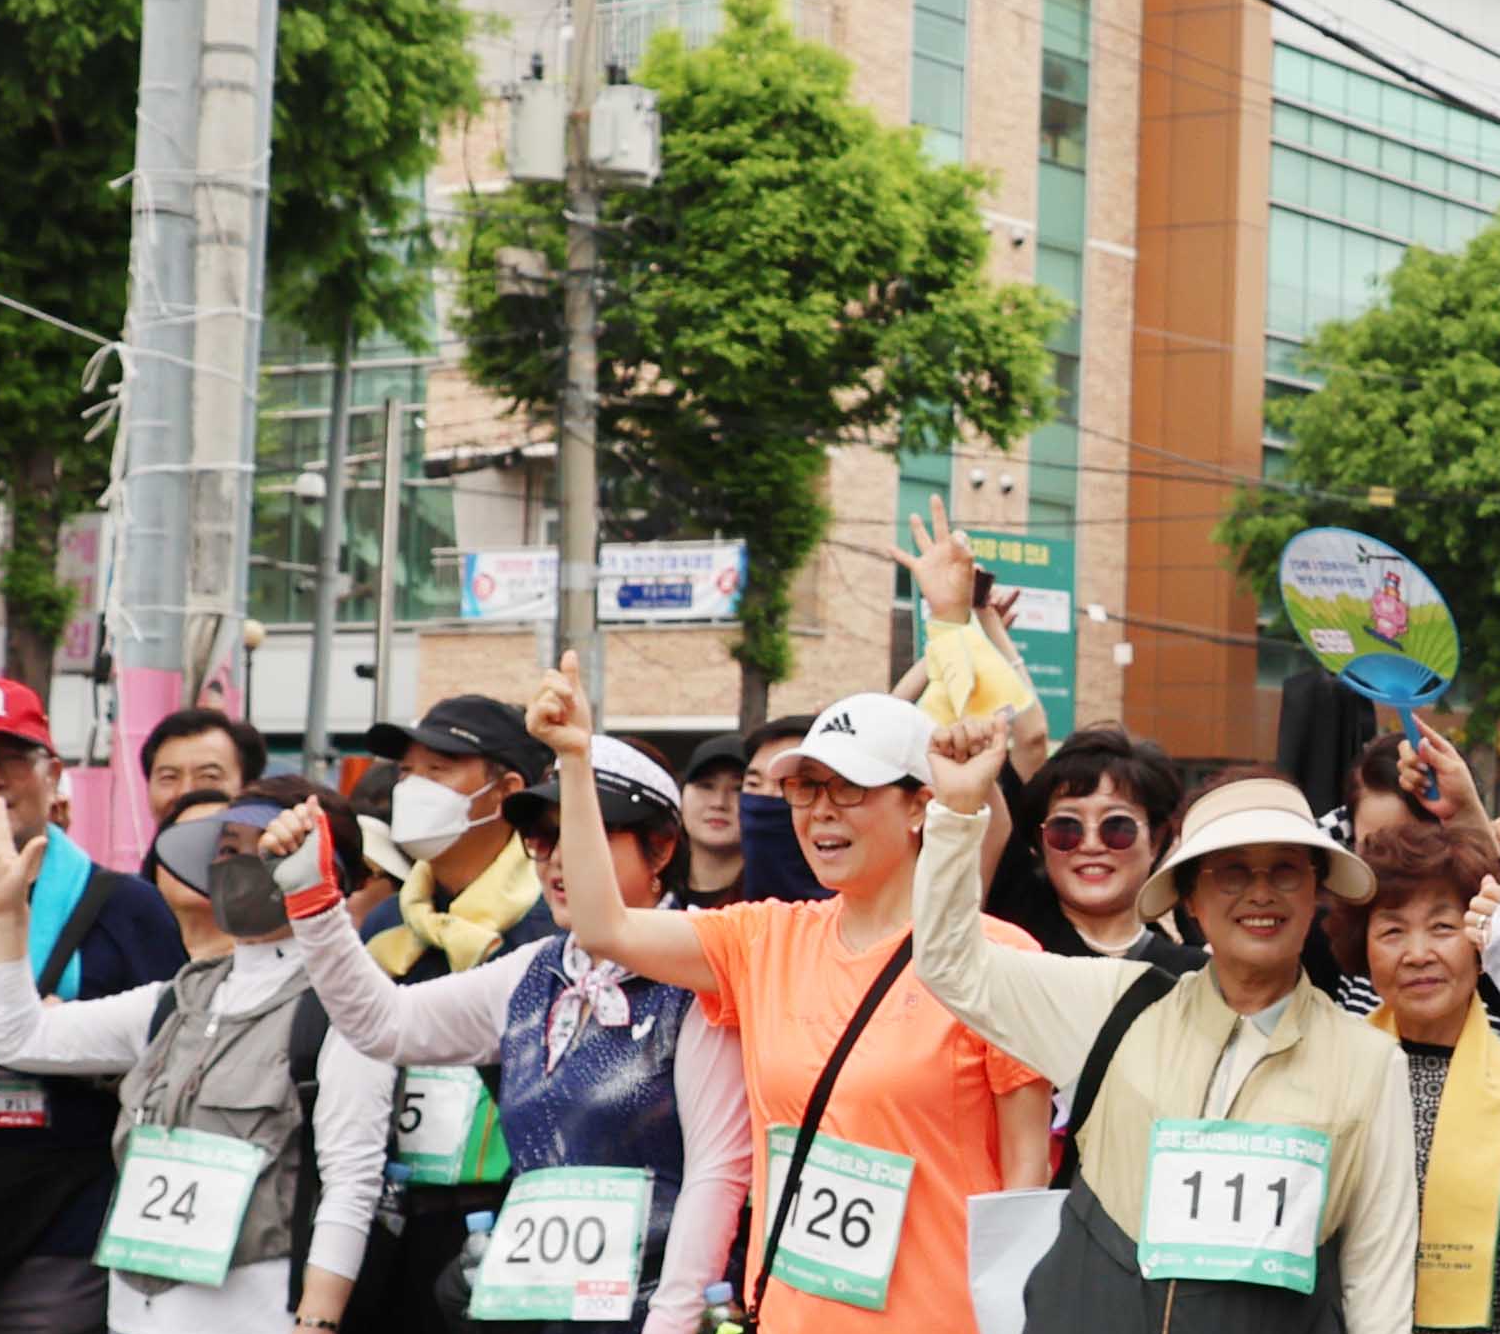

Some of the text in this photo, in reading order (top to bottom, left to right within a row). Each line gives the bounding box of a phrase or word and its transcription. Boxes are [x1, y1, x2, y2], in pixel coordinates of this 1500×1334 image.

[140, 1174, 199, 1225] 24
[1182, 1170, 1287, 1227] 111
[505, 1215, 606, 1265] 200
